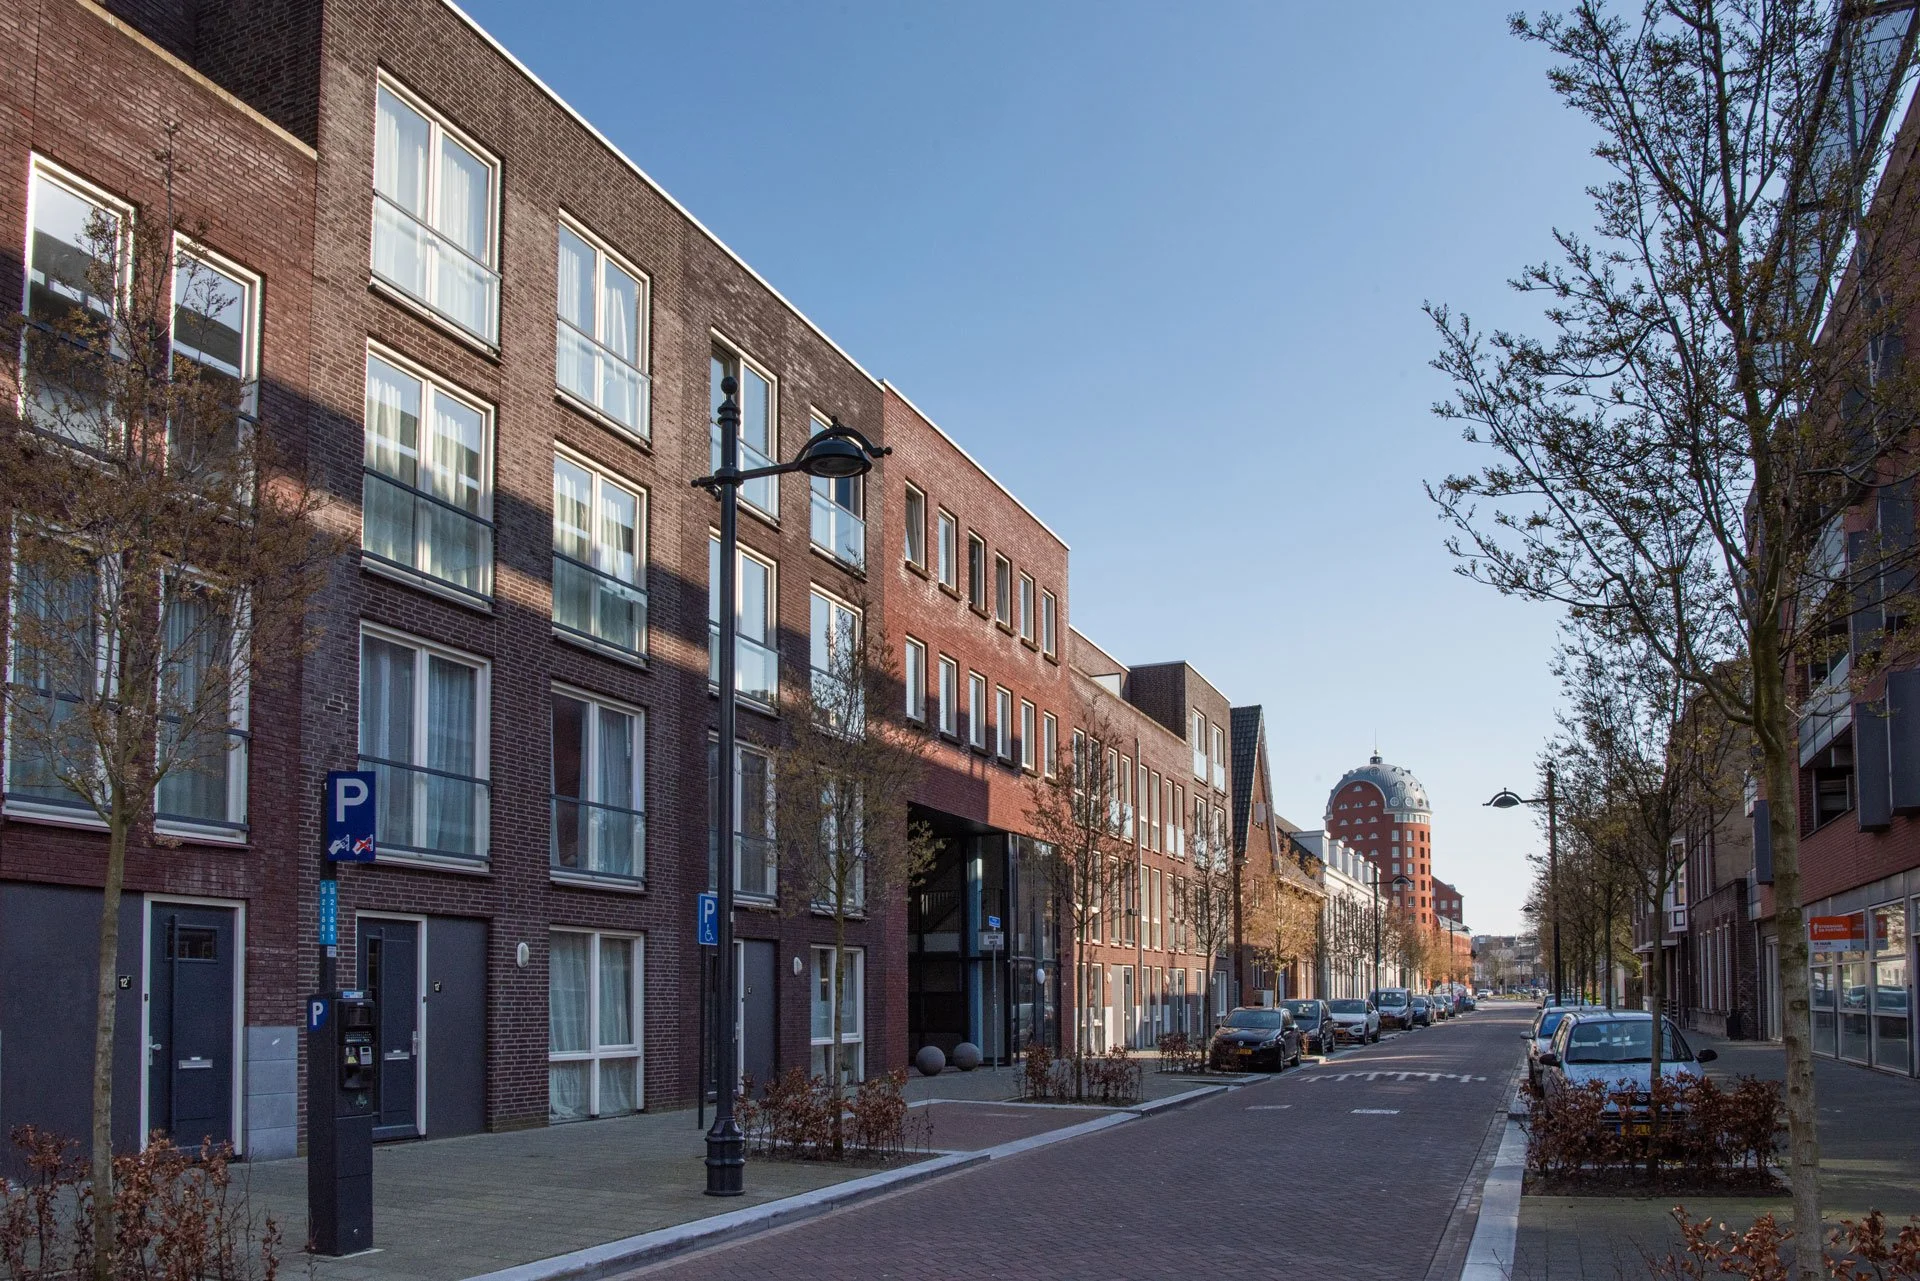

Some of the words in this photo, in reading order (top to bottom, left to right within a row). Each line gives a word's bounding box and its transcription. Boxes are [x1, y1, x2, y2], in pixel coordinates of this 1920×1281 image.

[336, 778, 369, 822] P
[704, 899, 715, 924] P
[312, 1001, 324, 1026] P
